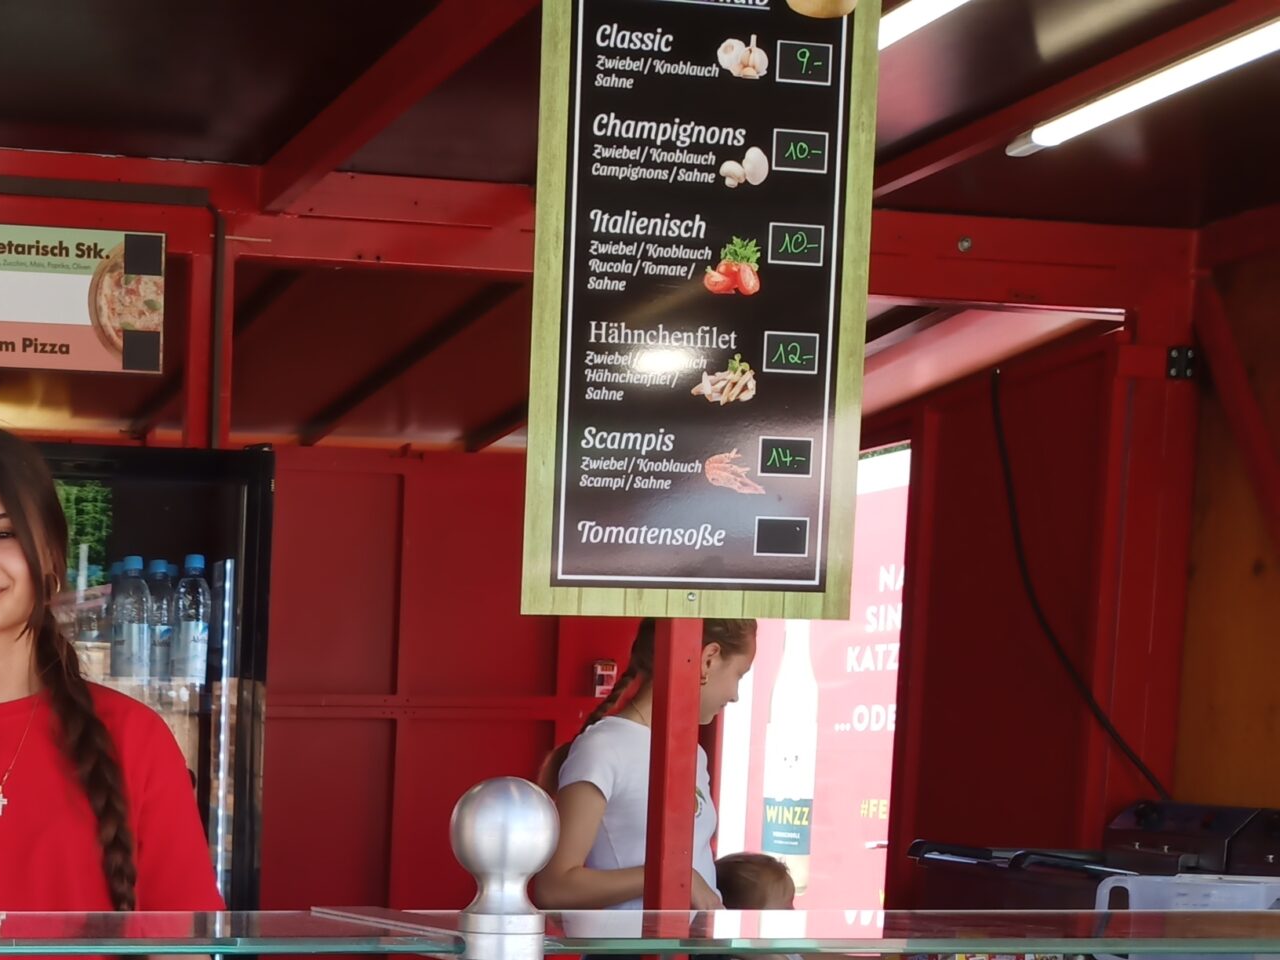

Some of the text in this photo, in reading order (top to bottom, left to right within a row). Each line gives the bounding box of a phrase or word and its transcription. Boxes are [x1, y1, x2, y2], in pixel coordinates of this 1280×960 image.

[596, 23, 674, 52] Classic
[594, 73, 634, 89] Sahne
[592, 112, 747, 147] Champignons
[589, 209, 707, 239] Italienisch
[75, 242, 110, 259] Stk.
[587, 276, 626, 291] Sahne
[22, 337, 70, 355] Pizza
[588, 320, 738, 349] Hähnchenfilet
[584, 386, 624, 401] Sahne
[580, 426, 675, 456] Scampis
[577, 520, 726, 550] Tomatensoße
[846, 642, 900, 673] KATZ
[766, 804, 810, 826] WINZZ
